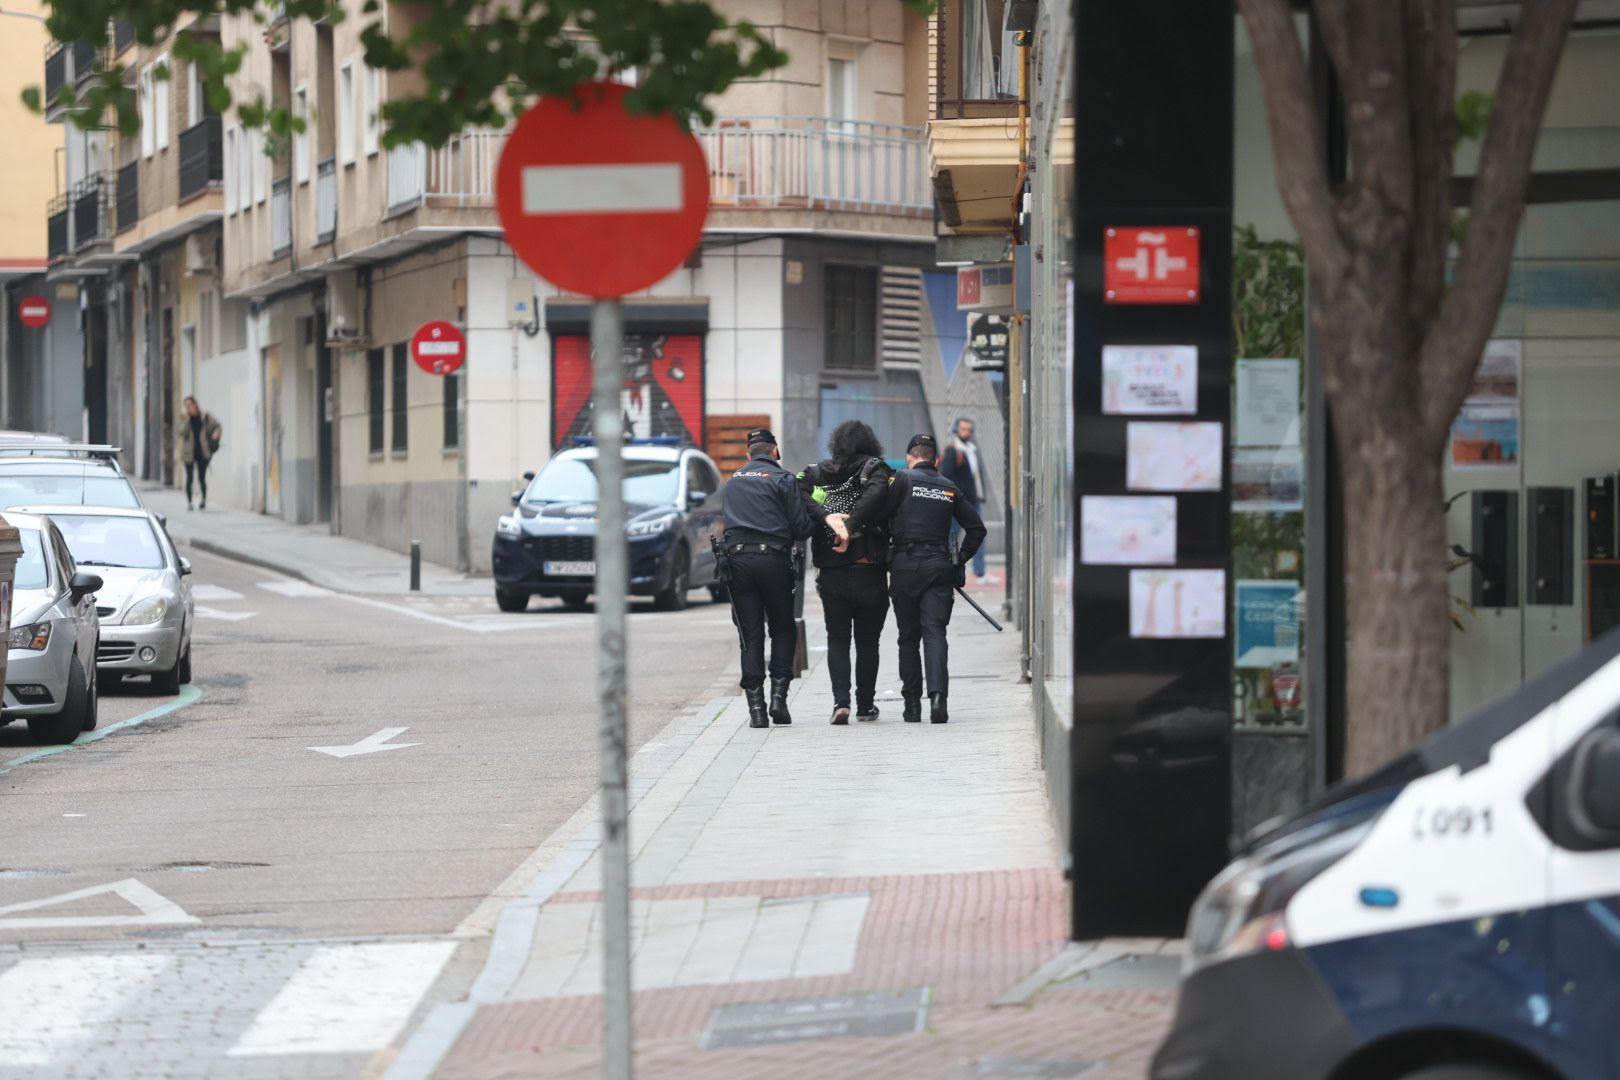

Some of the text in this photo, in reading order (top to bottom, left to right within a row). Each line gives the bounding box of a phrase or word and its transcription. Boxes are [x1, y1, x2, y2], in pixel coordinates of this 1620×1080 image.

[912, 486, 945, 495] POLICIA
[912, 491, 954, 502] NACIONAL
[1431, 805, 1492, 836] 091
